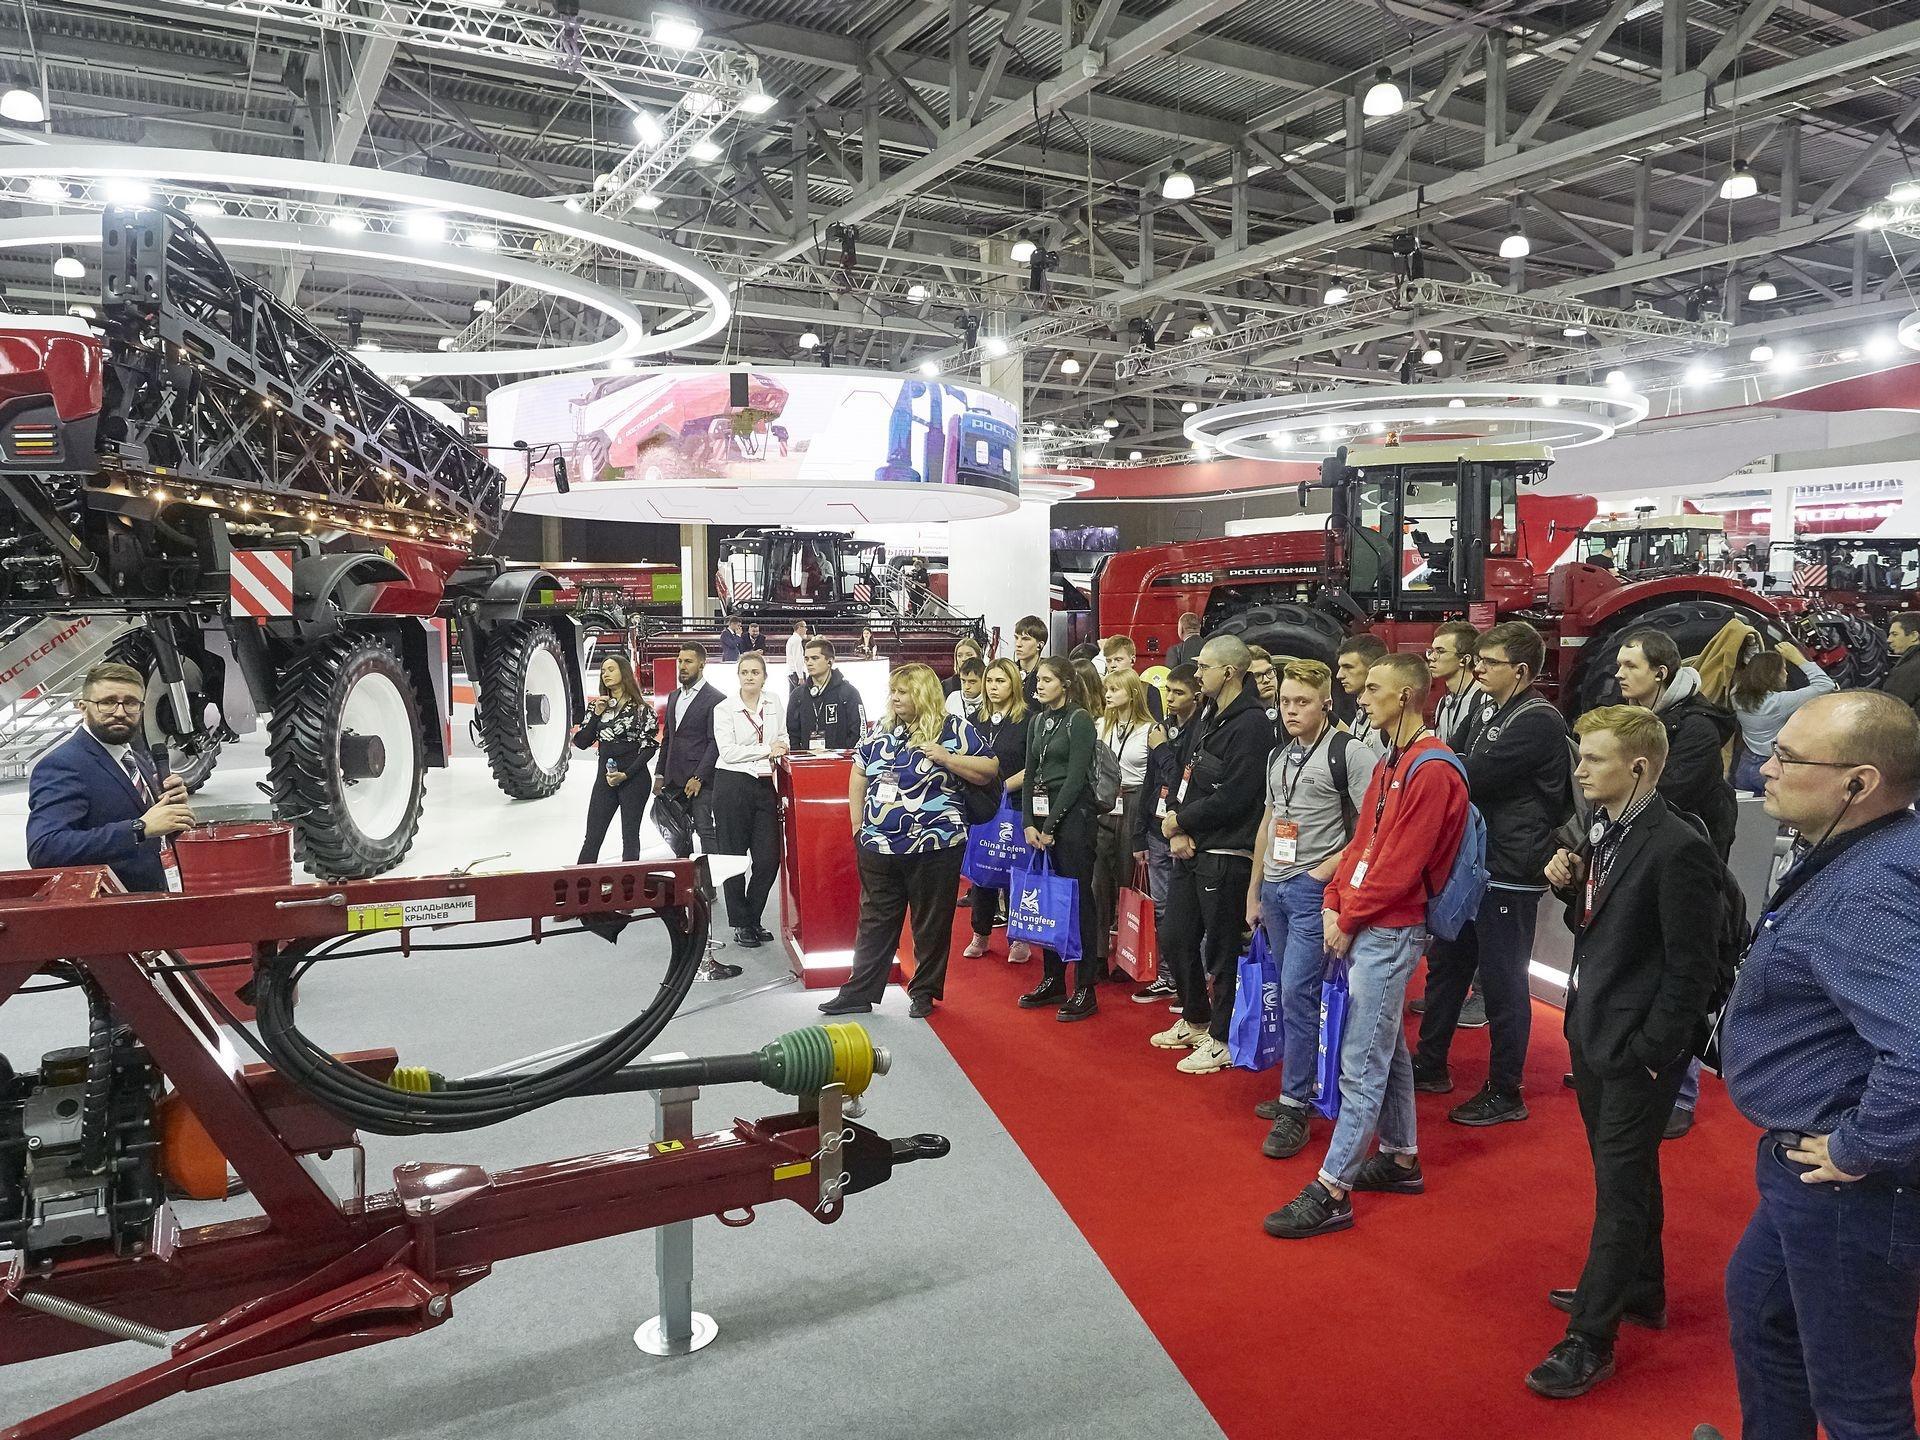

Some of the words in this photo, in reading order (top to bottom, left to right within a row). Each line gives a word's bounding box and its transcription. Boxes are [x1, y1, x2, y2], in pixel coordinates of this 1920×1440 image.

[1229, 567, 1317, 576] РОСТСЕЛЬМАШ
[1181, 572, 1214, 584] 3535
[0, 616, 91, 685] ОСТСЕЛЬМ
[979, 839, 1000, 850] China
[404, 900, 473, 913] СКЛАДЫВАНИЕ
[404, 911, 449, 922] КРЫЛЬЕВ
